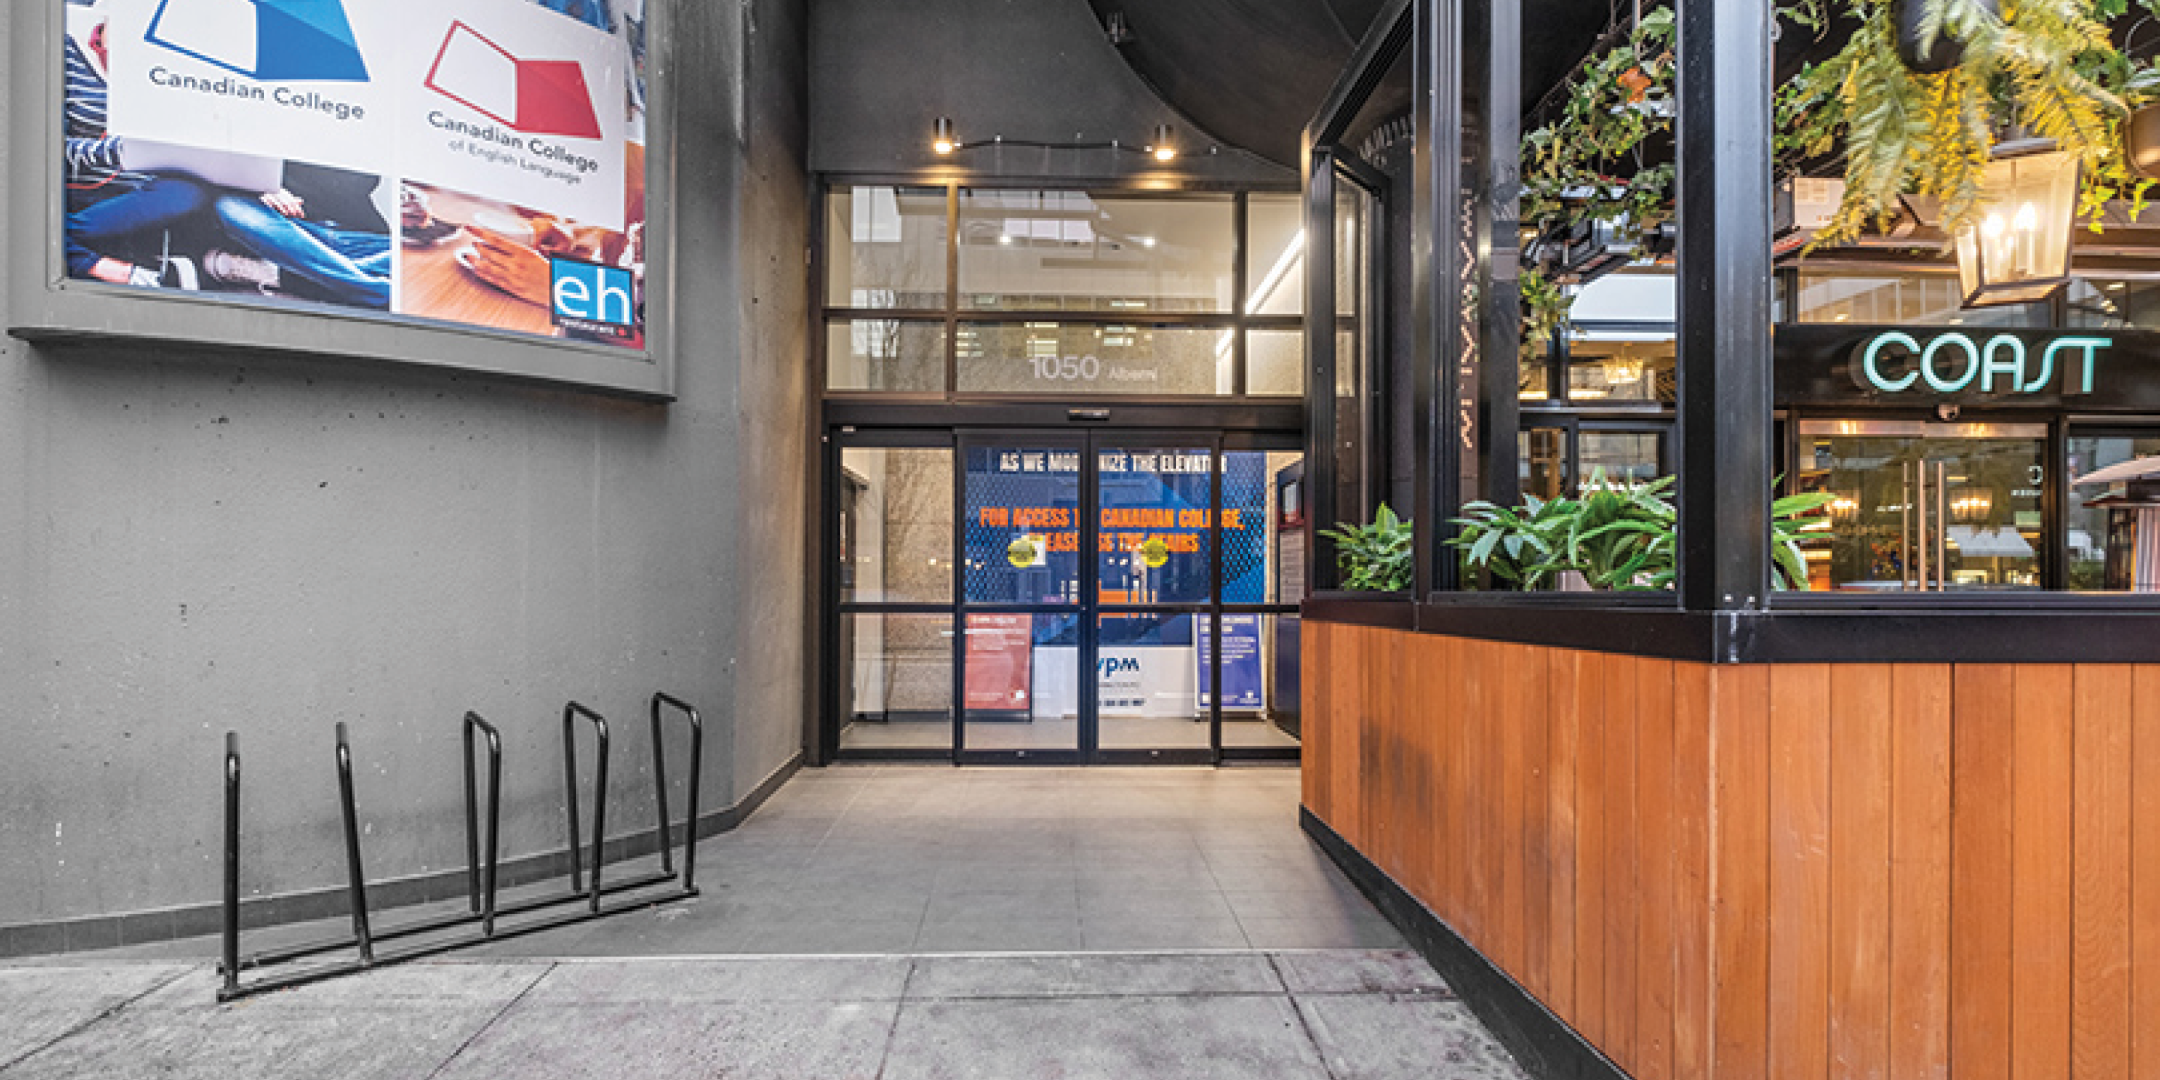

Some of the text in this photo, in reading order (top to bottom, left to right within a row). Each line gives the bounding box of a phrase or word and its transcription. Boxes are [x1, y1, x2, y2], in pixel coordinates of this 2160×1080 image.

[149, 66, 365, 120] Canadian College
[427, 110, 599, 173] Canadian College
[554, 268, 630, 325] eh
[1028, 355, 1100, 380] 1050
[1862, 330, 2113, 393] COAST
[1000, 452, 1020, 471] AS
[1023, 452, 1045, 471] WE
[1132, 454, 1158, 472] THE
[1159, 454, 1228, 473] ELEVATR
[980, 507, 1009, 527] FOR
[1013, 507, 1070, 527] ACCESS
[1101, 508, 1175, 528] CANADIAN
[1178, 508, 1246, 530] COLLGE,
